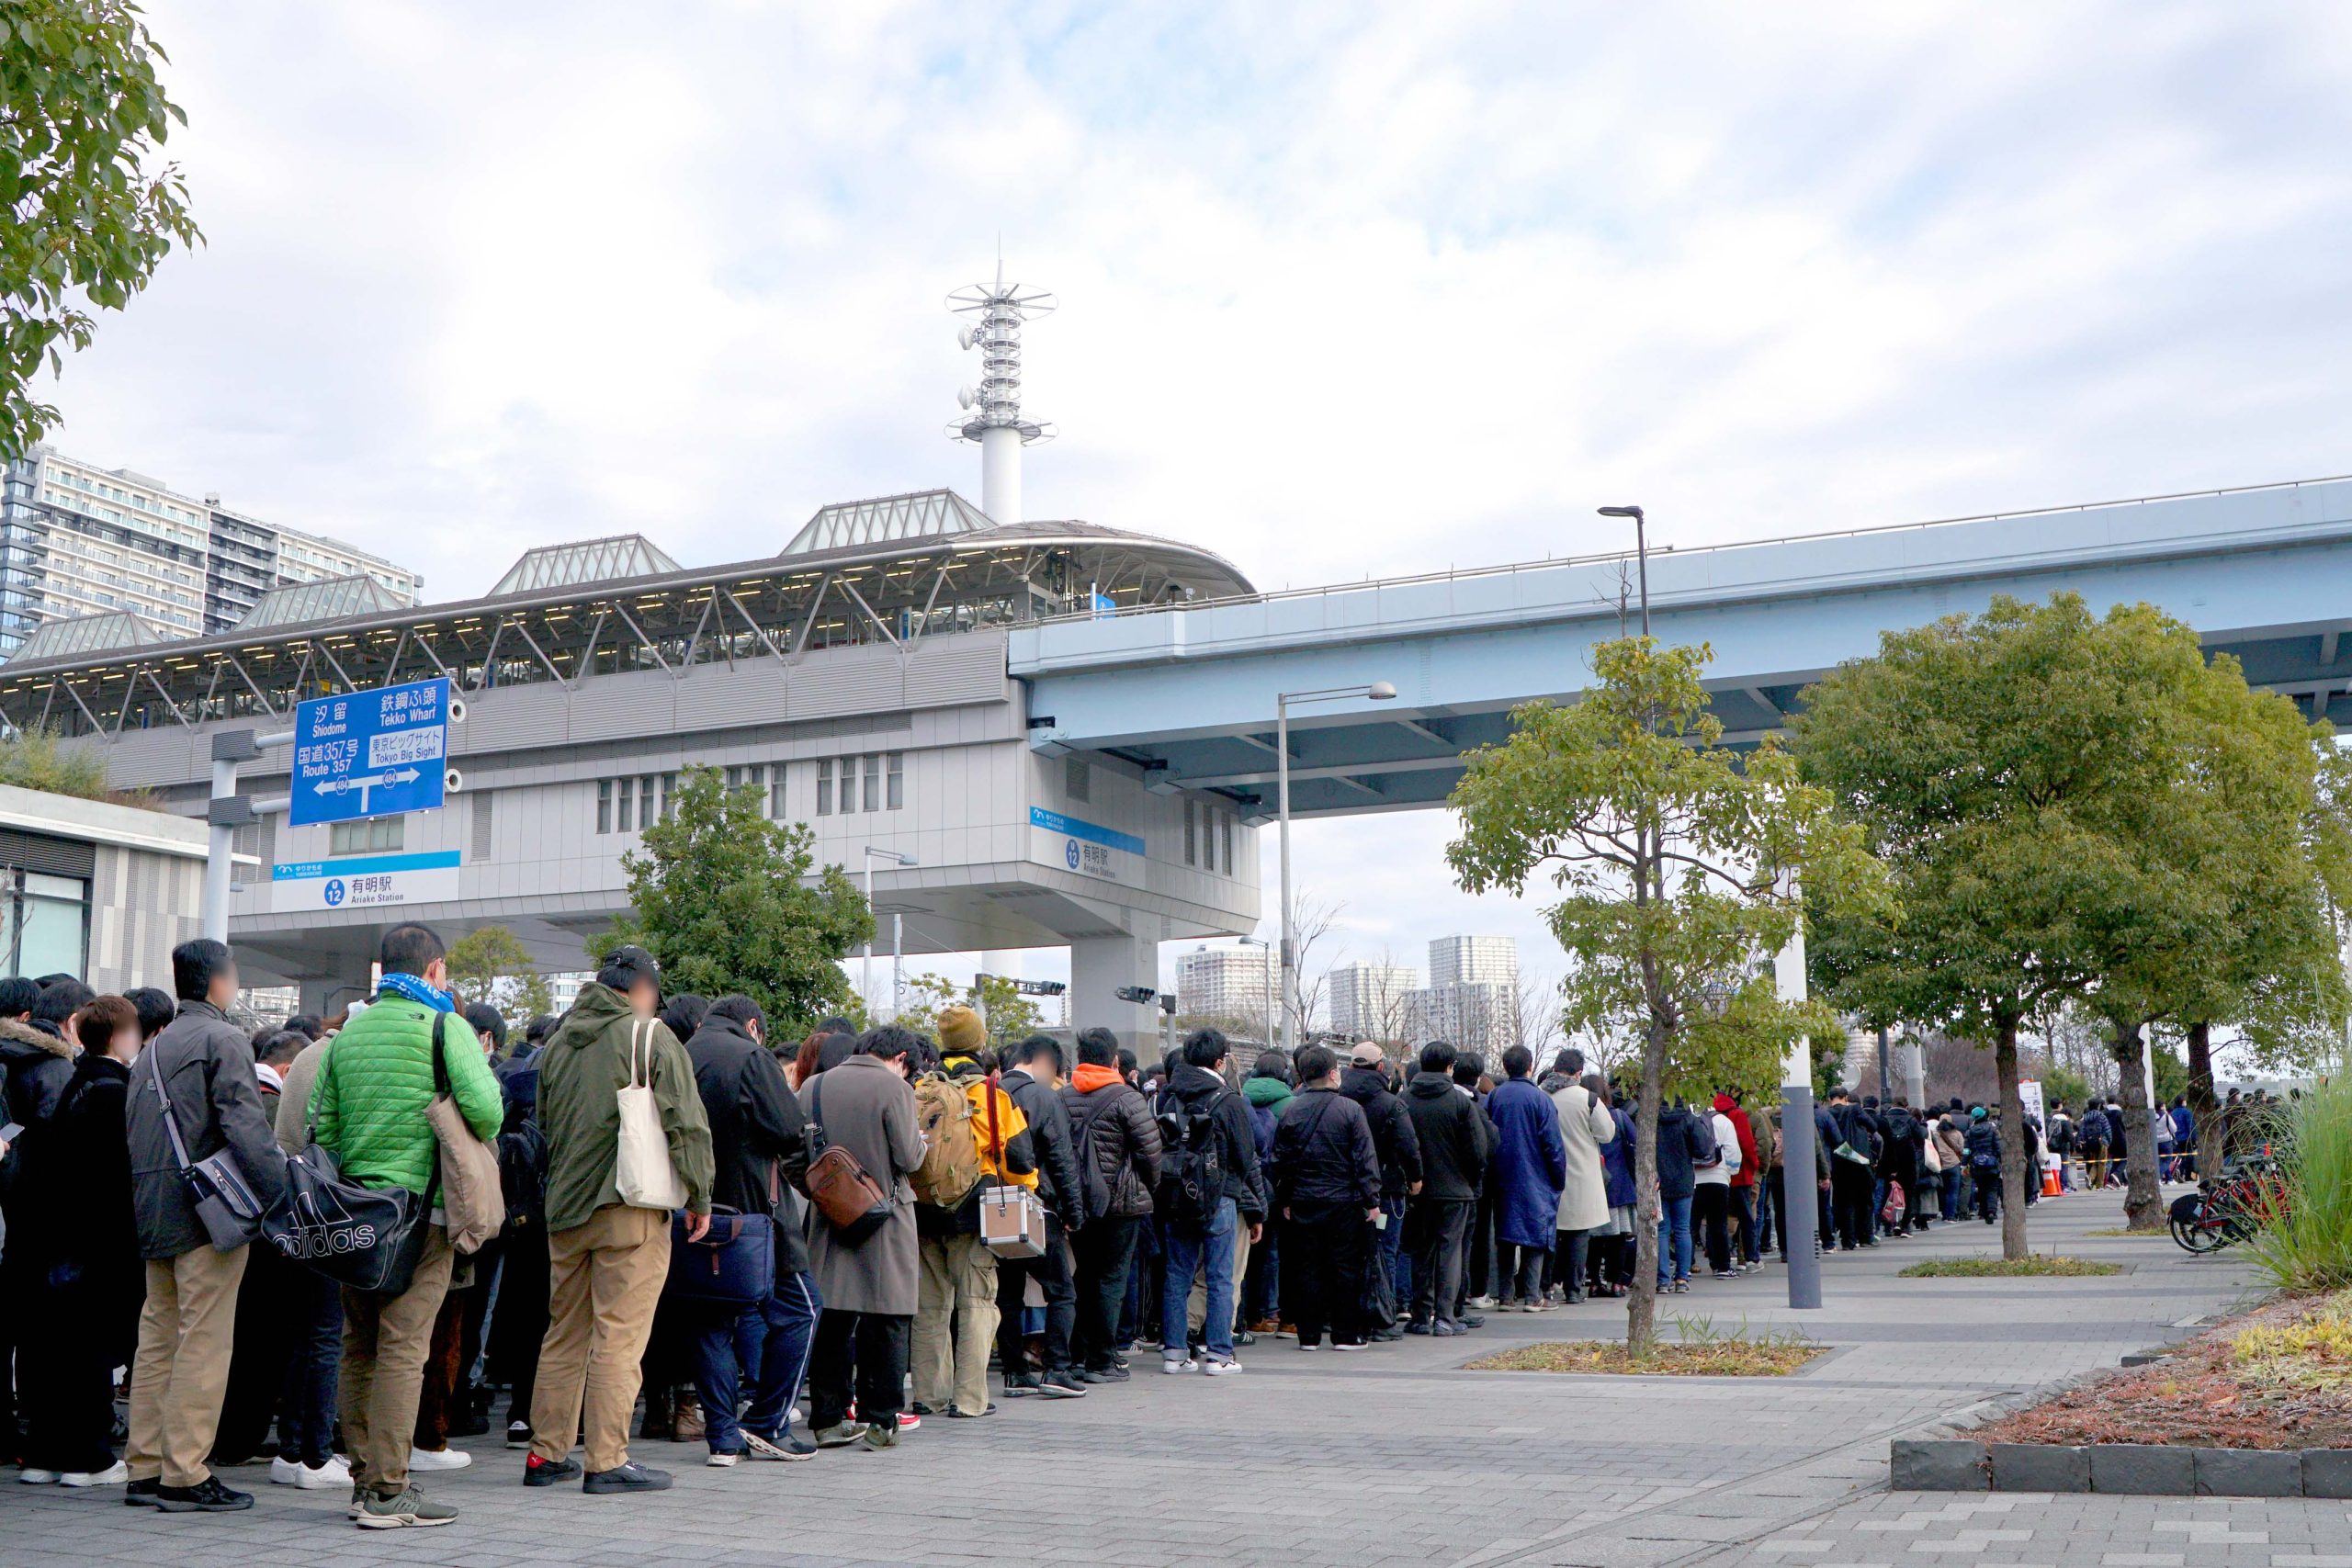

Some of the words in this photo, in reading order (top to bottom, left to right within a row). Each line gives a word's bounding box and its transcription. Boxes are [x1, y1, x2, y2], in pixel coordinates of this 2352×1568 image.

[380, 687, 437, 713] 鉄鋼ふ頭
[314, 702, 347, 724] 汐留
[380, 712, 406, 728] Tekko
[410, 705, 436, 722] Wharf
[312, 722, 347, 739] Shiodome
[371, 730, 440, 753] 東京ビッグサイト
[298, 739, 359, 765] 国道357号
[376, 752, 398, 764] Tokyo
[401, 750, 413, 761] Big
[416, 746, 436, 759] Sight
[302, 762, 329, 778] Route
[332, 759, 352, 773] 357
[337, 780, 348, 790] 484
[1069, 851, 1078, 865] 12
[1083, 844, 1108, 866] 有明駅
[351, 876, 391, 894] 有明駅
[328, 890, 341, 902] 12
[351, 894, 376, 904] Ariake
[378, 892, 404, 902] Station
[273, 1224, 376, 1259] adidas
